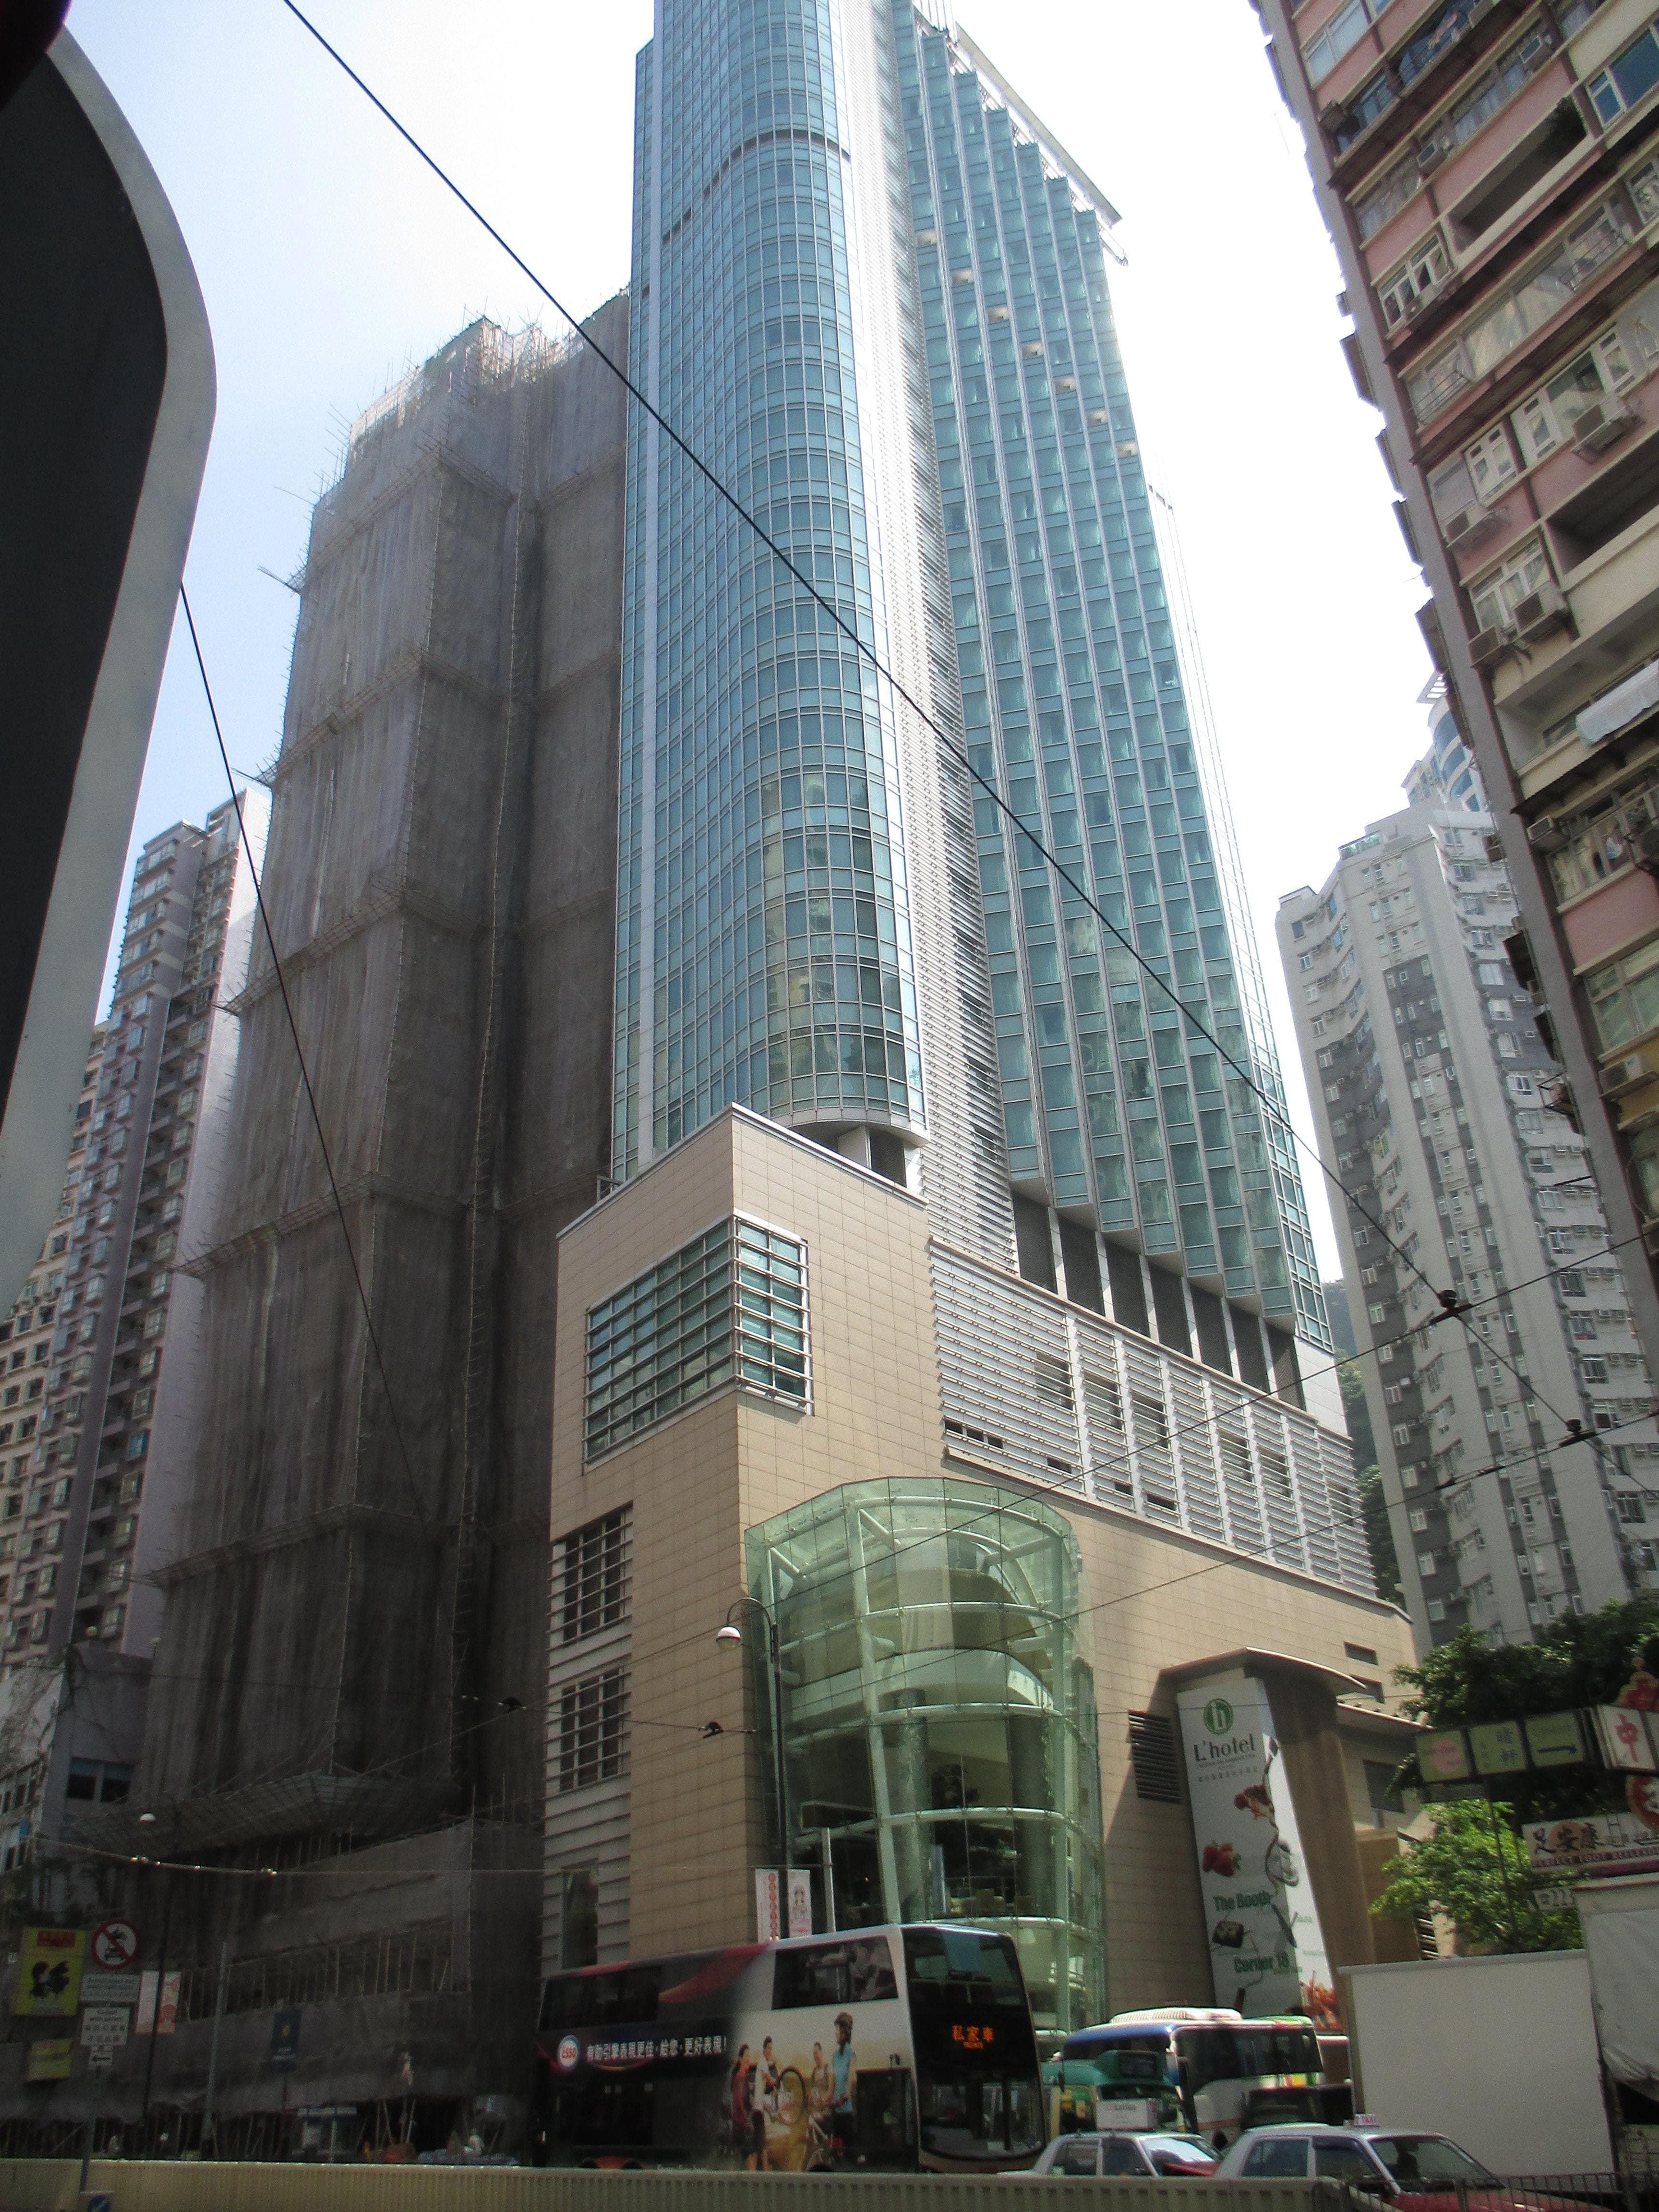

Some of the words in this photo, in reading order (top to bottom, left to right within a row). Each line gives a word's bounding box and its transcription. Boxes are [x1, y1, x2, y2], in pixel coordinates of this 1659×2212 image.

[1193, 1733, 1255, 1761] L'hotel
[1213, 1896, 1236, 1911] The
[952, 2024, 994, 2043] 私家車
